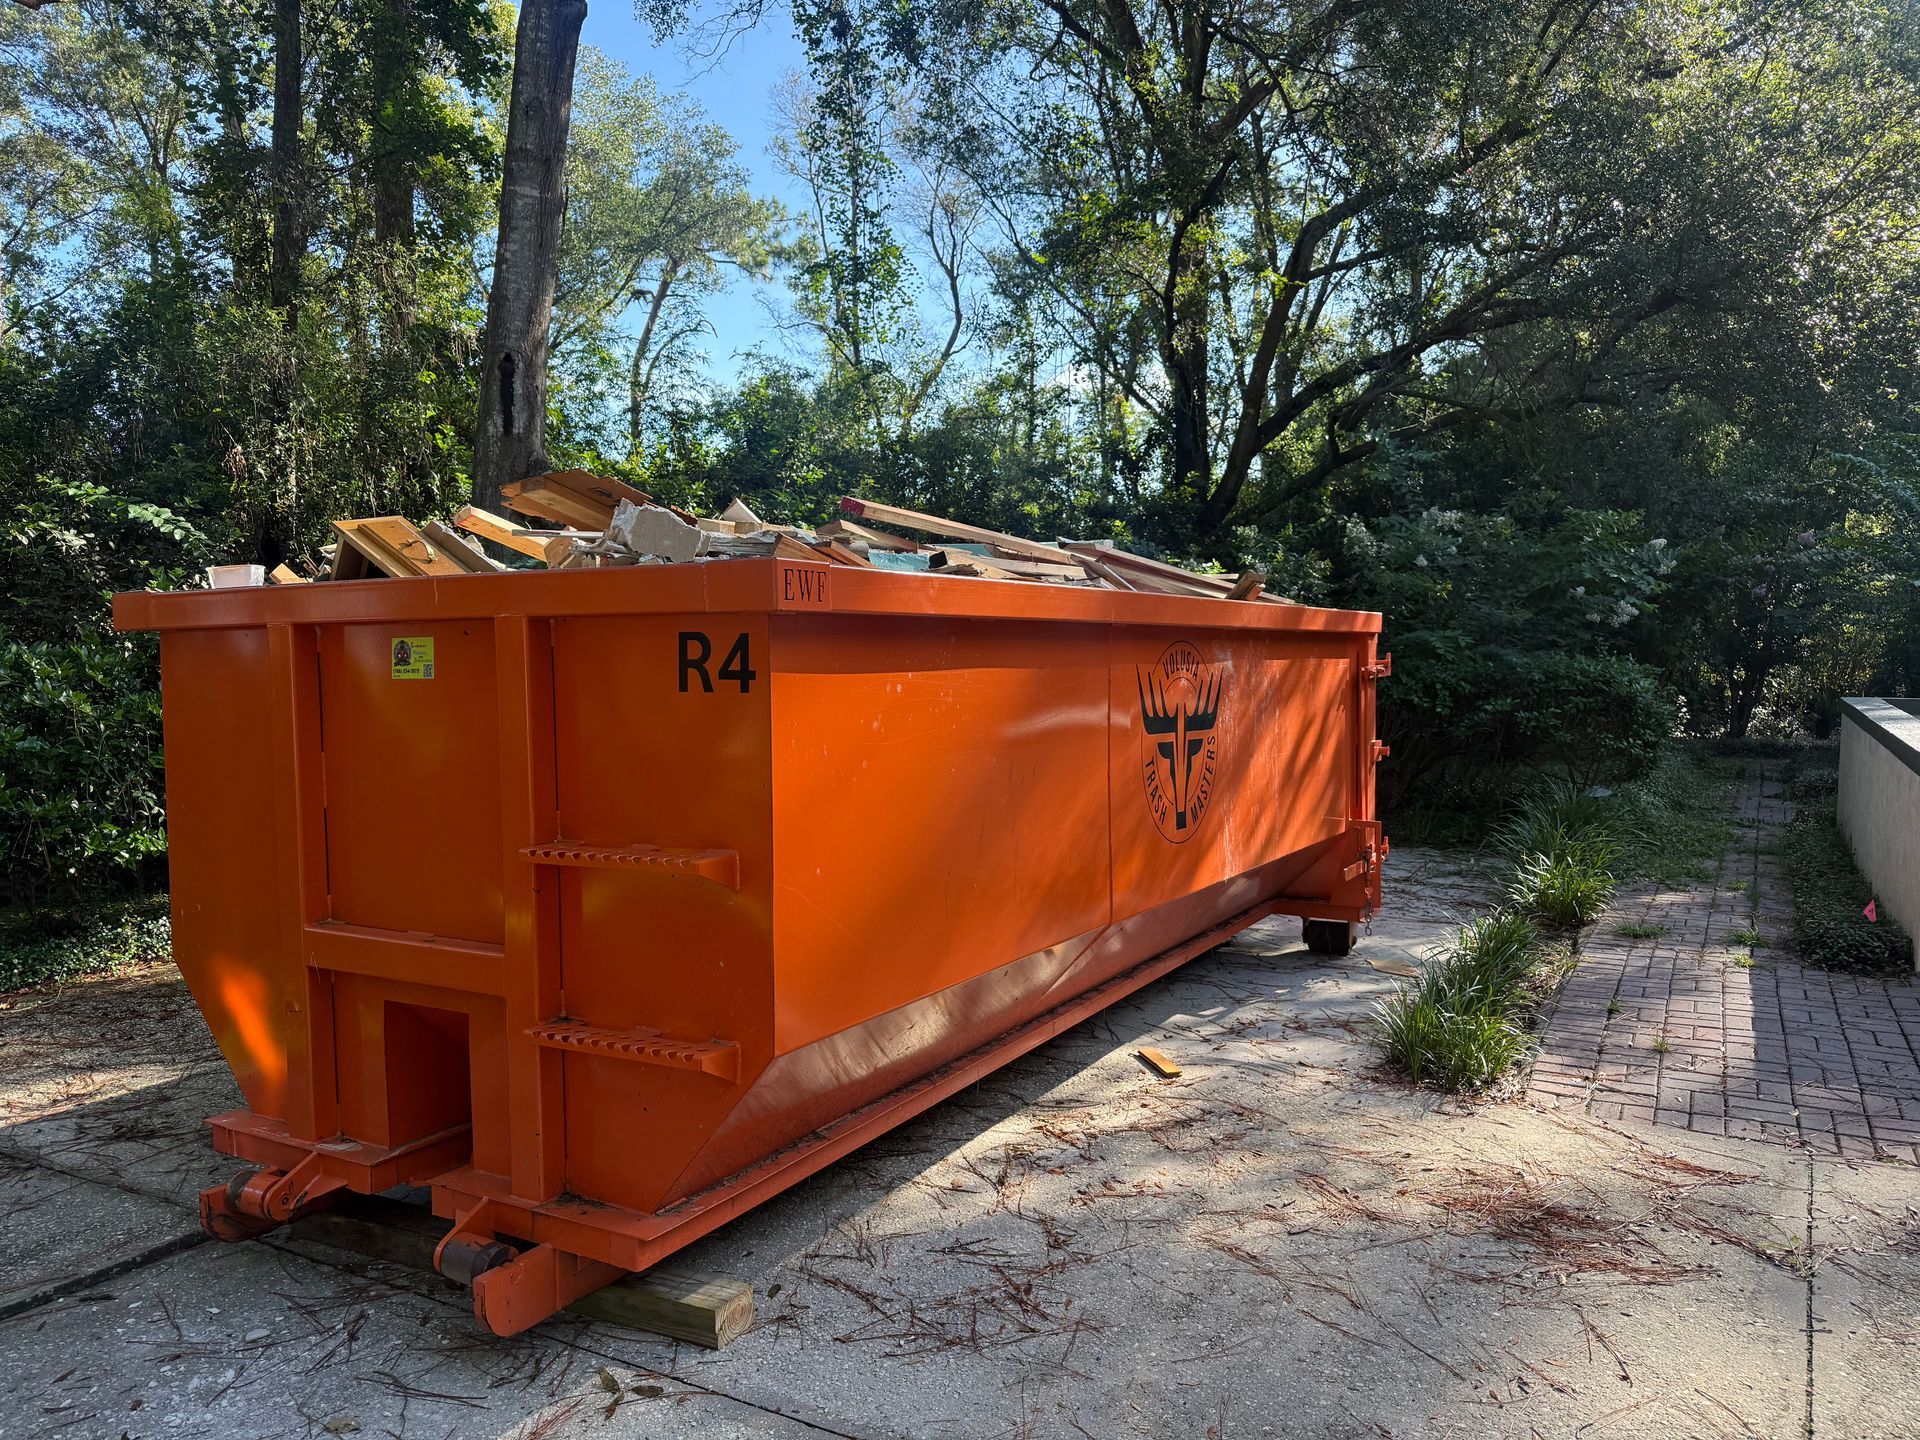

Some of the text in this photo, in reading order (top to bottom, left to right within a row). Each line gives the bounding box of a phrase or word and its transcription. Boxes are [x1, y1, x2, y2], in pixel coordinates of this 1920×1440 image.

[783, 568, 827, 603] EWF
[678, 631, 757, 694] R4
[1162, 648, 1200, 682] VOLUSIA
[1145, 735, 1217, 826] TRASH MASTERS
